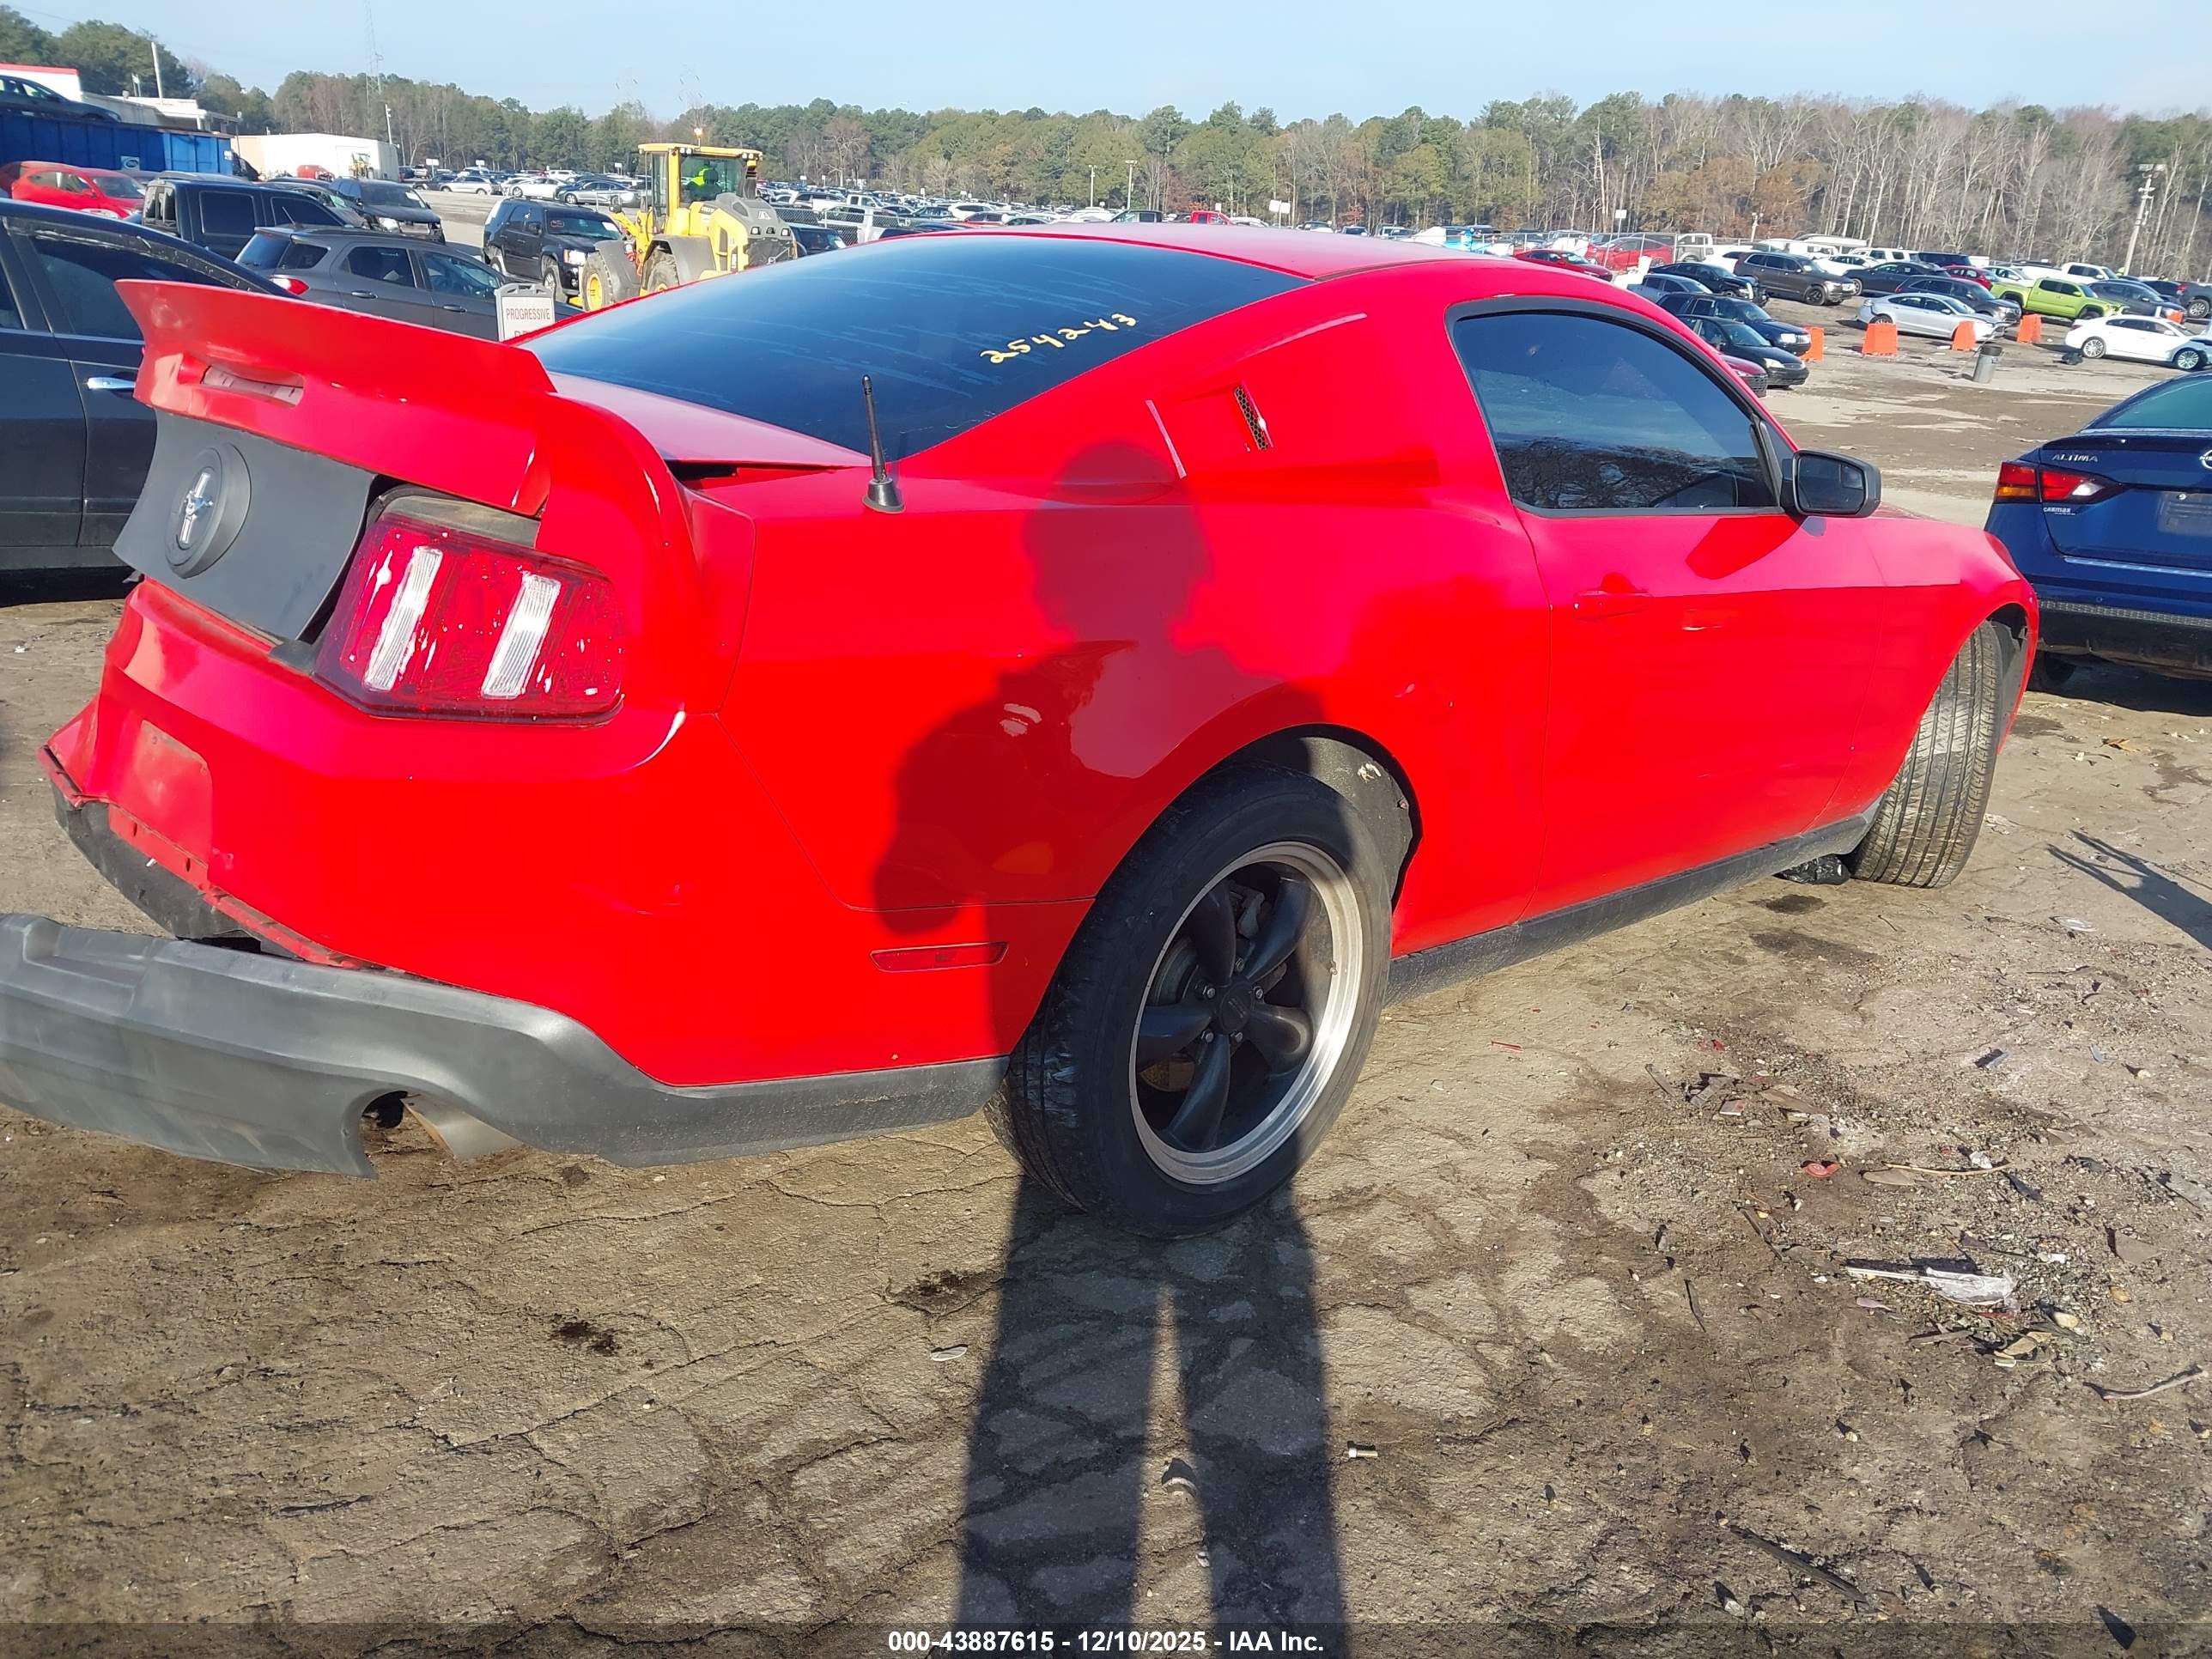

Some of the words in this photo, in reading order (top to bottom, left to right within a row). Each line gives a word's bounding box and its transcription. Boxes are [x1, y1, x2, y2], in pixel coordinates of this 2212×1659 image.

[506, 307, 550, 320] PROGRESSIVE
[980, 313, 1137, 364] 254243
[2051, 453, 2099, 462] ALTIMA
